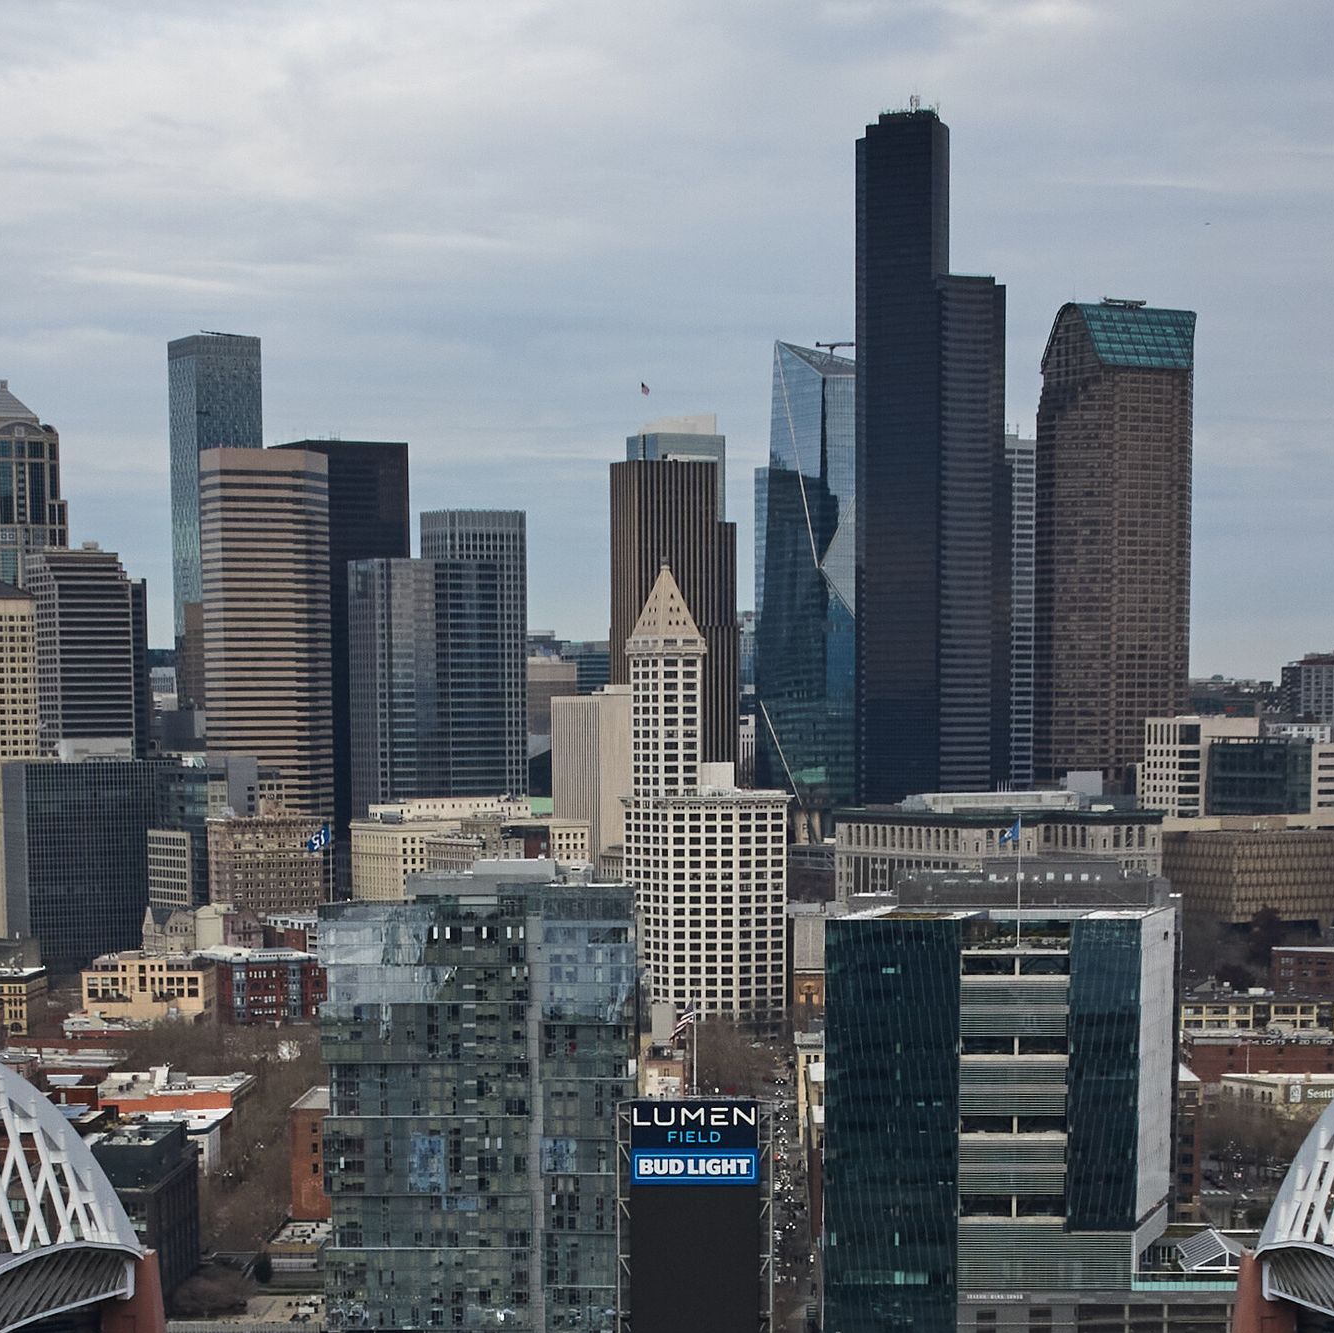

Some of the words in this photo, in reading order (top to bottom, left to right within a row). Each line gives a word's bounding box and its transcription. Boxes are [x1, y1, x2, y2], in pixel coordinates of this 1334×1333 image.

[632, 1107, 756, 1126] LUMEN
[667, 1131, 721, 1143] FIELD
[638, 1158, 685, 1175] BUD
[686, 1158, 750, 1175] LIGHT
